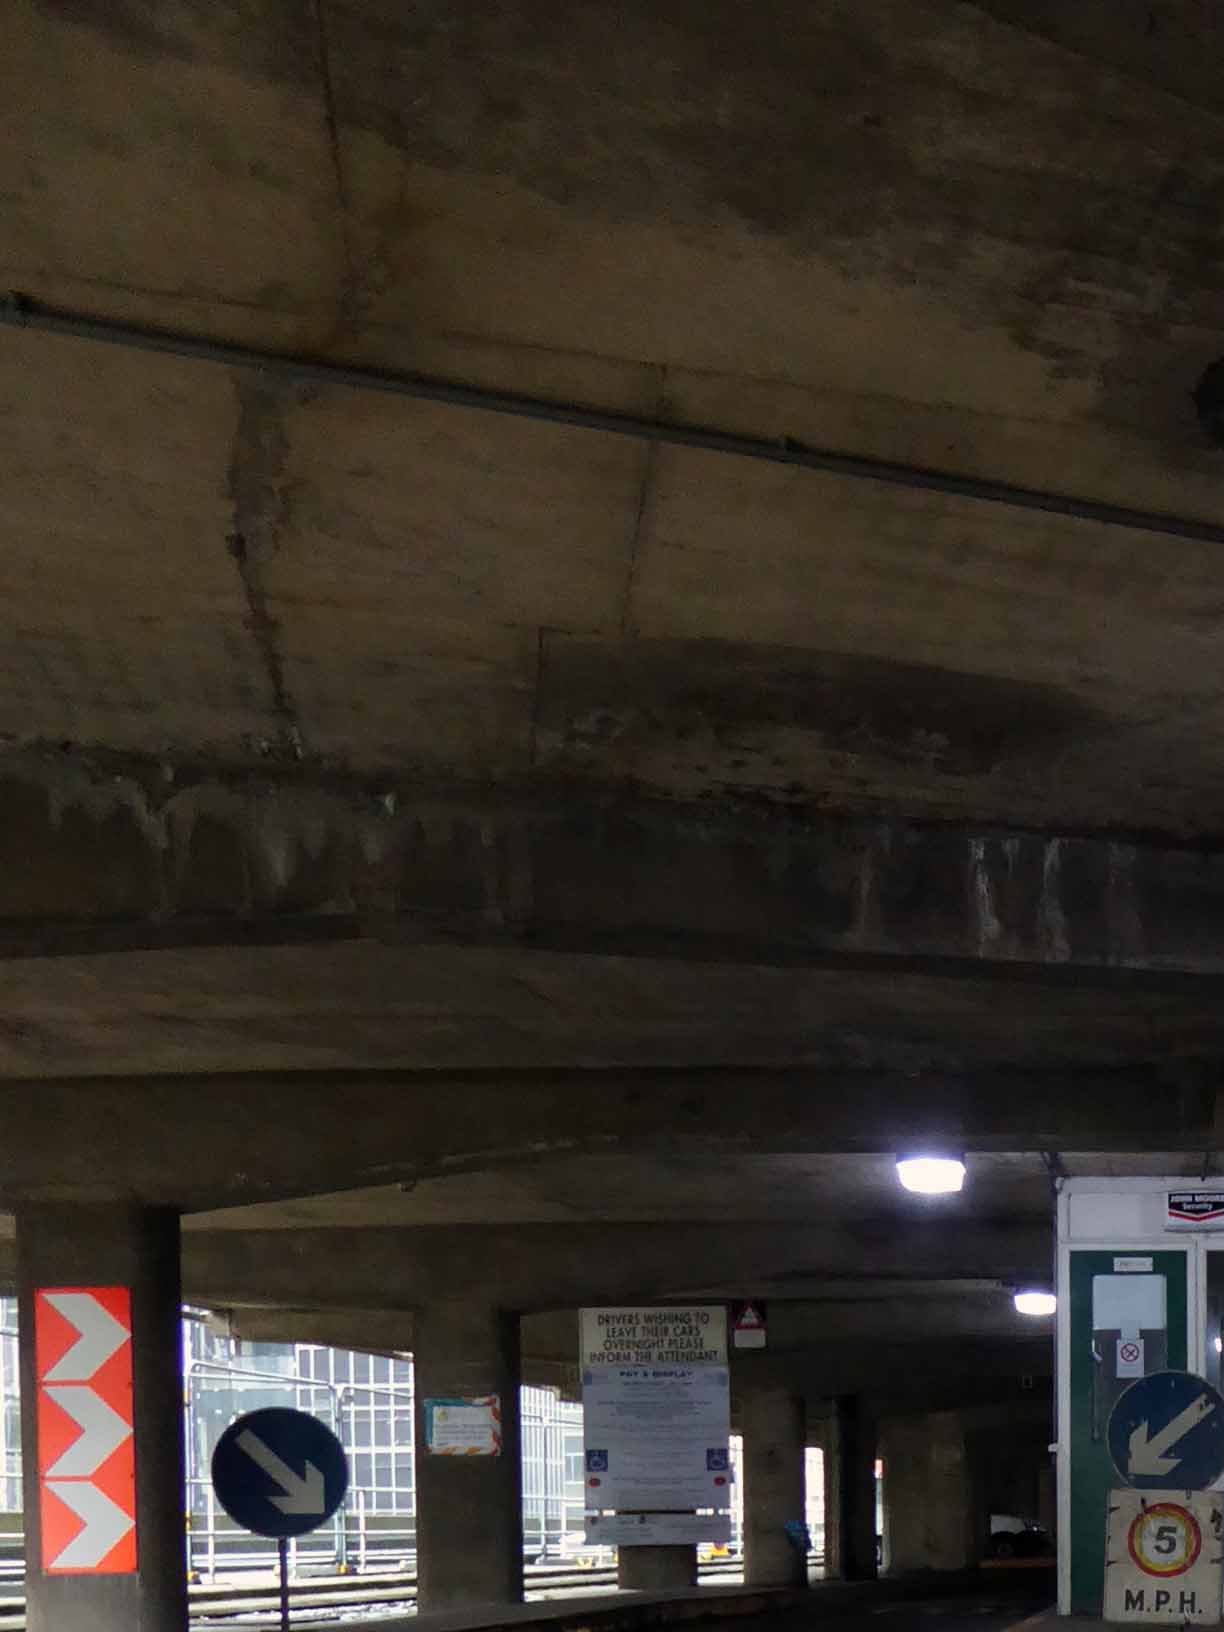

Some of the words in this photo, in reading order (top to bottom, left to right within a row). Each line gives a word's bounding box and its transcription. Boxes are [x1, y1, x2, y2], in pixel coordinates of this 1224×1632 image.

[1182, 1202, 1213, 1211] Security
[597, 1313, 640, 1327] DRIVERS
[643, 1312, 691, 1326] WISHING
[694, 1311, 710, 1325] TO
[606, 1326, 637, 1338] LEAVE
[641, 1326, 669, 1337] THEIR
[672, 1325, 701, 1337] CARS
[603, 1338, 665, 1351] OVERNIGHT
[668, 1337, 704, 1350] PLEASE
[590, 1351, 631, 1363] INFORM
[635, 1351, 652, 1362] THE
[657, 1350, 719, 1362] ATTENDANT
[619, 1370, 638, 1378] PAY
[652, 1370, 693, 1378] DISPLAY
[1154, 1526, 1177, 1554] 5
[1124, 1588, 1203, 1615] M.P.H.
